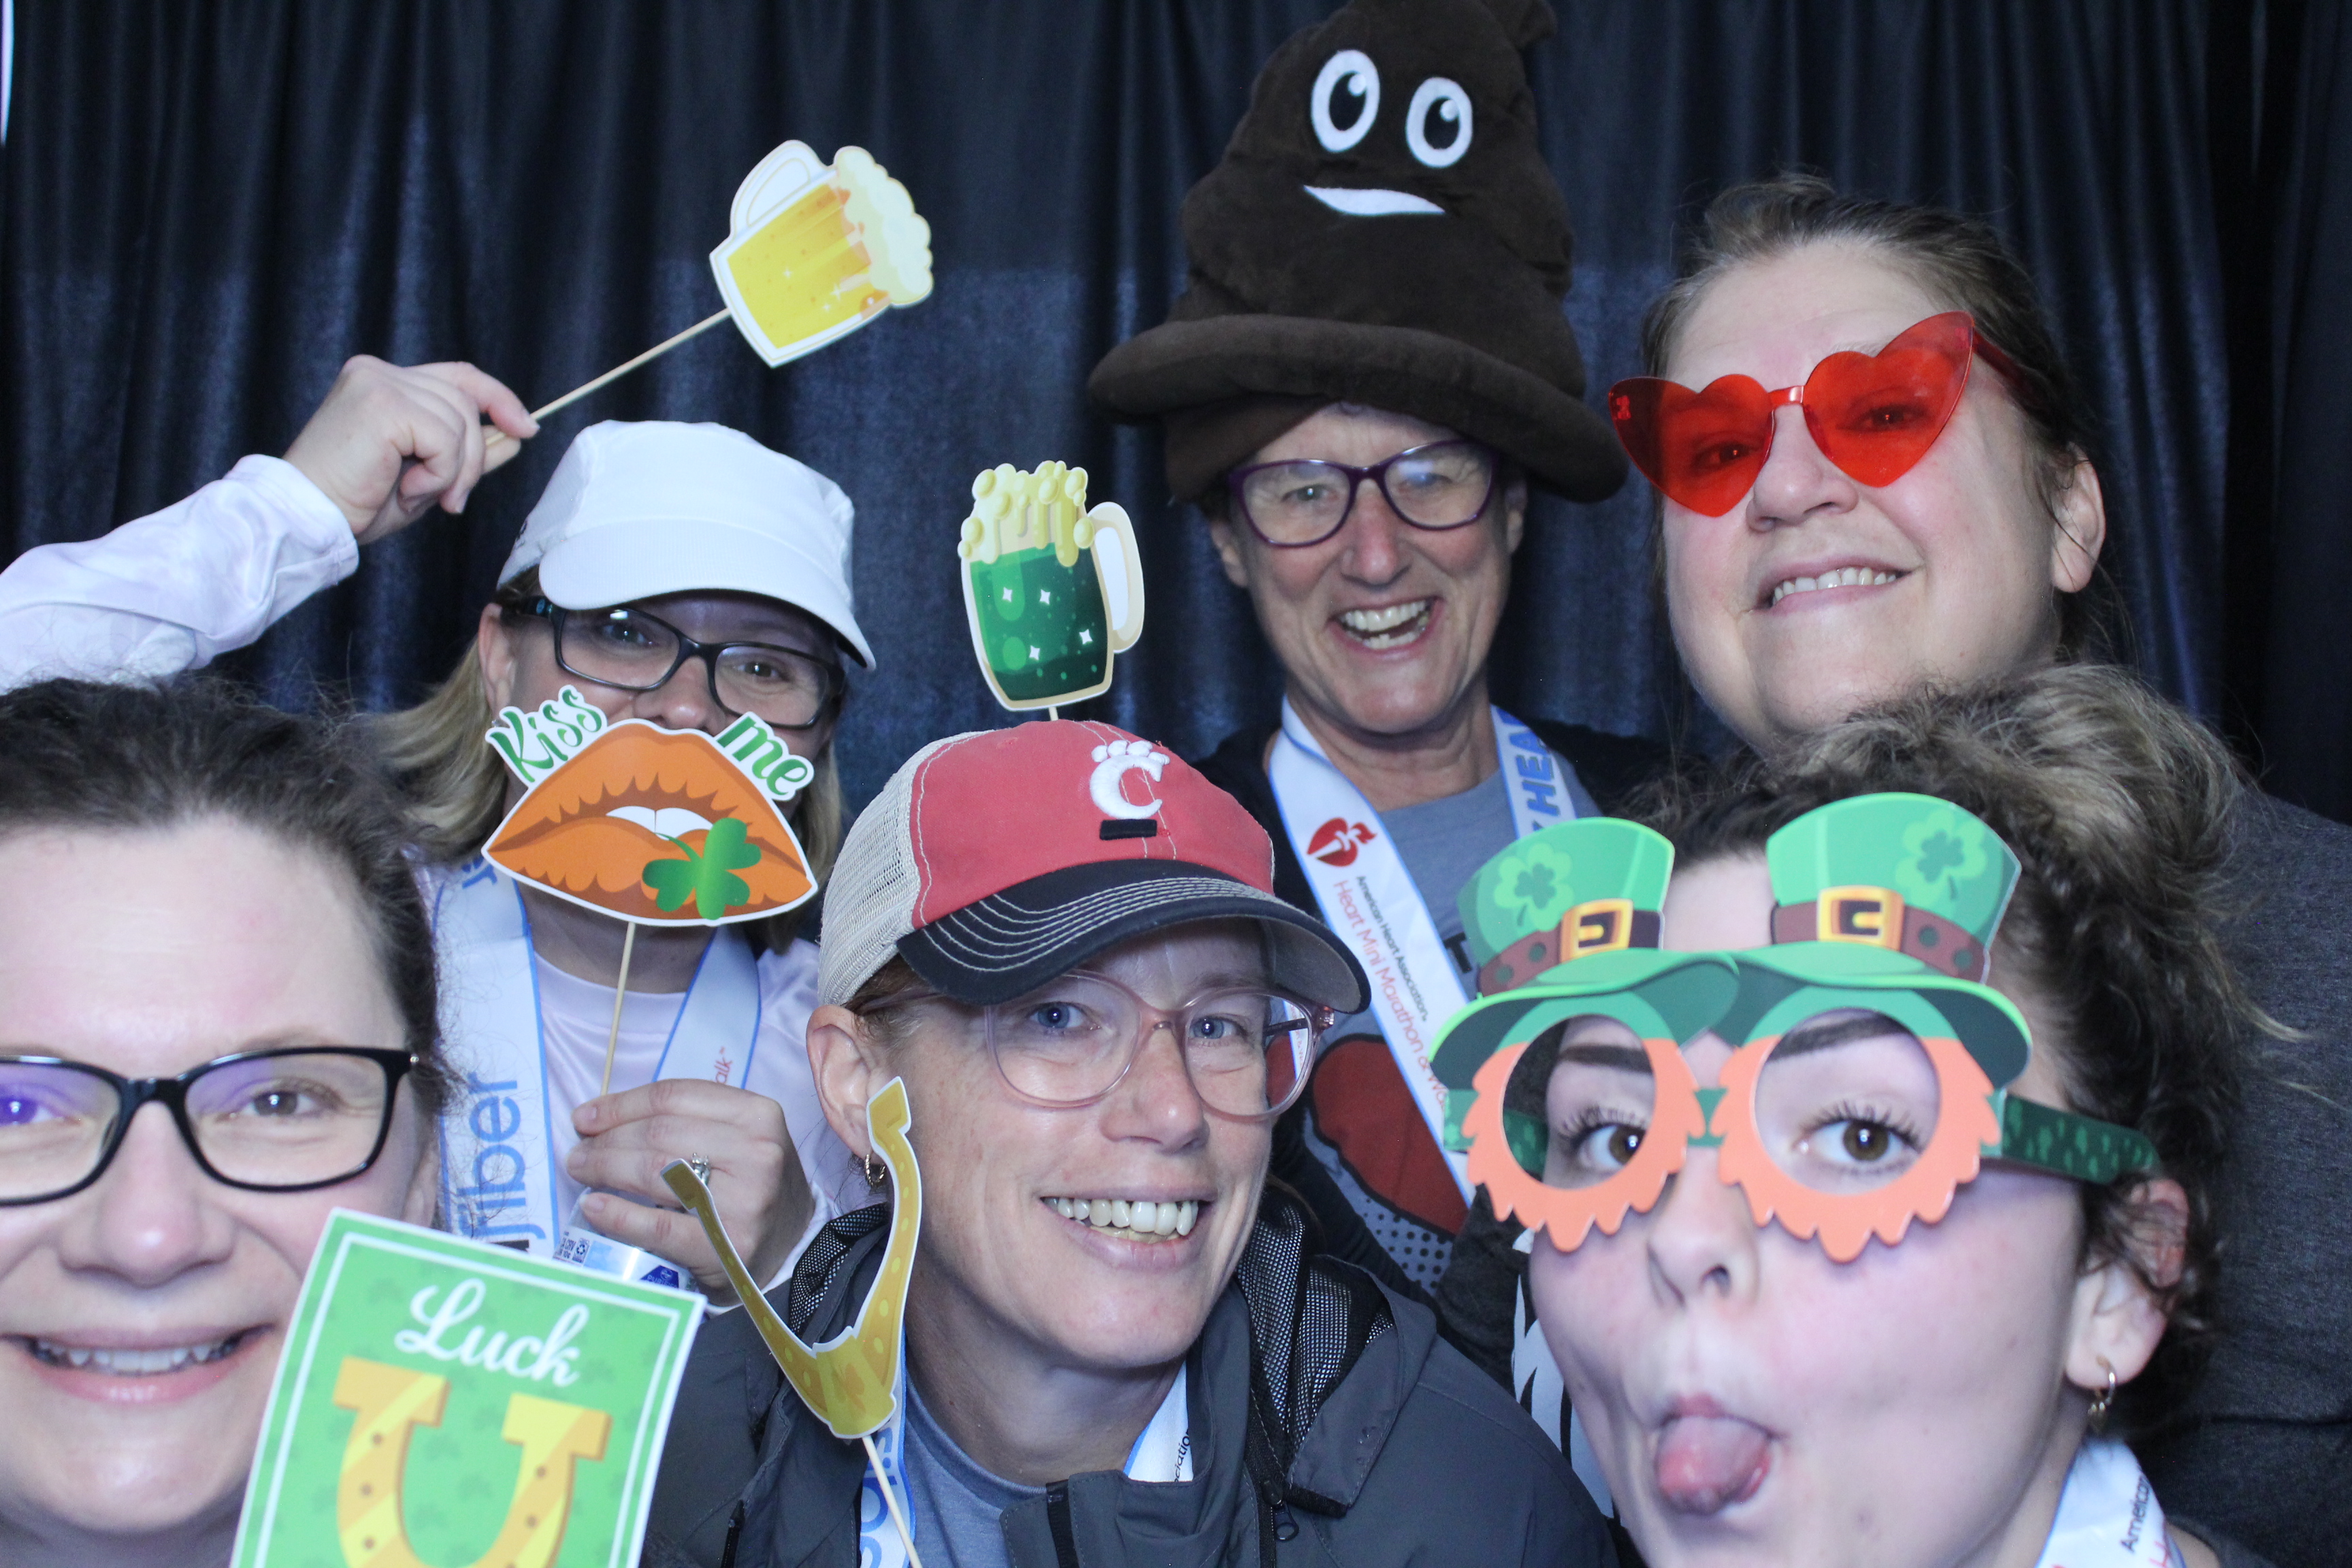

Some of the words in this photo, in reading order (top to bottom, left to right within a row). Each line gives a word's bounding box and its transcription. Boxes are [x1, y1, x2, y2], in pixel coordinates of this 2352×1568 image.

[490, 689, 602, 783] Kiss
[716, 716, 808, 789] me
[1090, 740, 1170, 819] C
[1333, 880, 1365, 929] Heart
[1356, 928, 1386, 966] Mini
[1375, 966, 1424, 1053] Marathon
[1356, 875, 1384, 924] American
[1380, 923, 1400, 955] Heart
[457, 1071, 546, 1251] fiber
[394, 1278, 590, 1387] Luck
